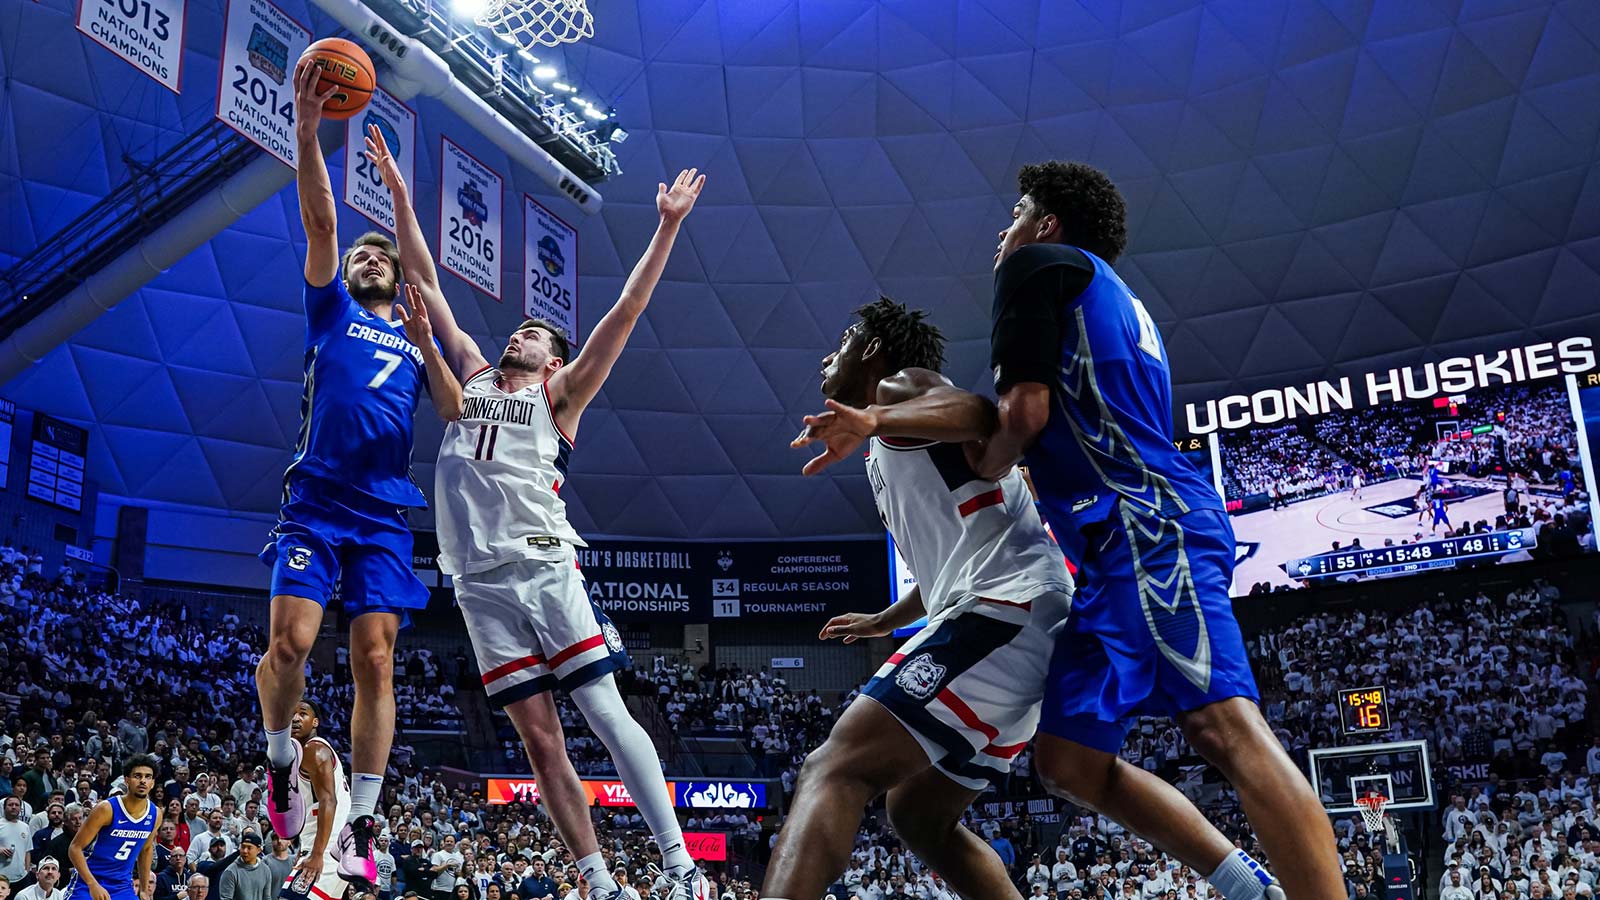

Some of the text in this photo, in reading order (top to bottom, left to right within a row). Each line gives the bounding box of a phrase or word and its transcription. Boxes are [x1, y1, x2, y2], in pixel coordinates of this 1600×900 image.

[98, 7, 164, 60] NATIONAL
[250, 5, 292, 42] Basketball
[91, 22, 168, 80] CHAMPIONS
[232, 65, 295, 127] 2014
[234, 96, 291, 143] NATIONAL
[371, 100, 401, 124] asketball
[228, 110, 294, 161] CHAMPIONS
[353, 194, 396, 229] CHAMPIO
[357, 181, 395, 212] NATION
[449, 216, 495, 263] 2016
[446, 256, 496, 293] CHAMPIONS
[450, 243, 492, 277] NATIONAL
[531, 268, 572, 312] 2025
[533, 295, 569, 325] NATIONAL
[367, 348, 404, 389] 7
[1185, 335, 1596, 435] UCONN HUSKIES
[474, 424, 500, 461] 11
[616, 551, 692, 569] BASKETBALL
[777, 555, 842, 564] CONFERENCE
[1336, 538, 1484, 569] 55 15:48 48
[770, 565, 849, 574] CHAMPIONSHIPS
[589, 581, 689, 600] ATIONAL
[716, 581, 850, 593] 34 REGULAR SEASON
[601, 600, 691, 612] MPIONSHIPS
[720, 602, 827, 614] 11 TOURNAMENT
[793, 659, 800, 667] 6
[1348, 690, 1382, 706] 15:48
[1359, 704, 1381, 728] 16
[509, 782, 541, 798] VIZ
[602, 784, 632, 798] VIZ
[1027, 798, 1054, 814] WORLD
[114, 841, 137, 860] 5
[171, 884, 188, 892] UCO
